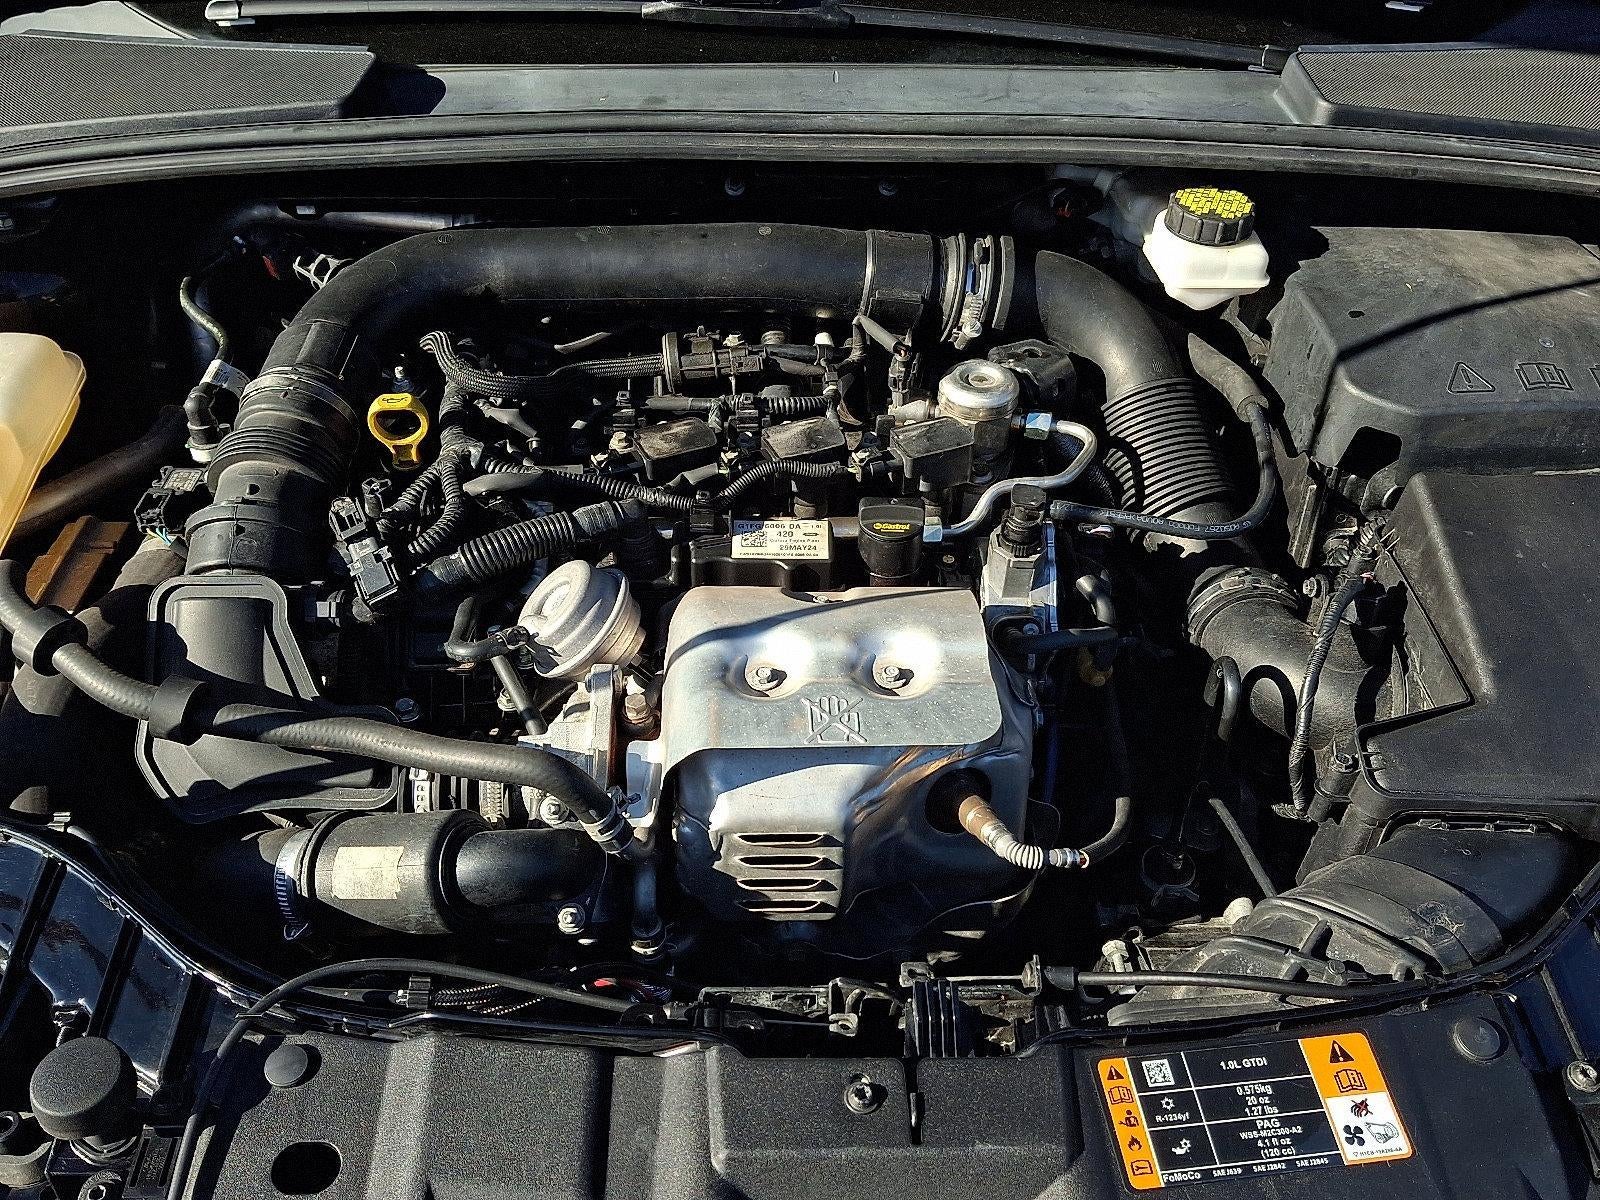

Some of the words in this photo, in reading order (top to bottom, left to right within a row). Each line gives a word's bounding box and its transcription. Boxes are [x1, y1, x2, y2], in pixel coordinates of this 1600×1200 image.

[1219, 1059, 1242, 1071] 1.0L
[1242, 1056, 1268, 1069] GTDI
[1236, 1083, 1273, 1096] 0.575kg
[1245, 1096, 1258, 1106] 20
[1259, 1096, 1271, 1104] oz
[1155, 1111, 1190, 1123] R-1234yf
[1244, 1106, 1264, 1117] 1.27
[1264, 1105, 1279, 1115] lbs
[1255, 1118, 1281, 1130] PAG
[1257, 1138, 1271, 1148] 4.1
[1271, 1137, 1280, 1146] fl
[1280, 1137, 1292, 1145] oz
[1260, 1148, 1280, 1159] (120
[1281, 1145, 1296, 1156] cc)
[1252, 1163, 1266, 1173] SAE
[1295, 1159, 1309, 1168] SAE
[1162, 1172, 1201, 1184] FoMoCo
[1212, 1168, 1226, 1178] SAE
